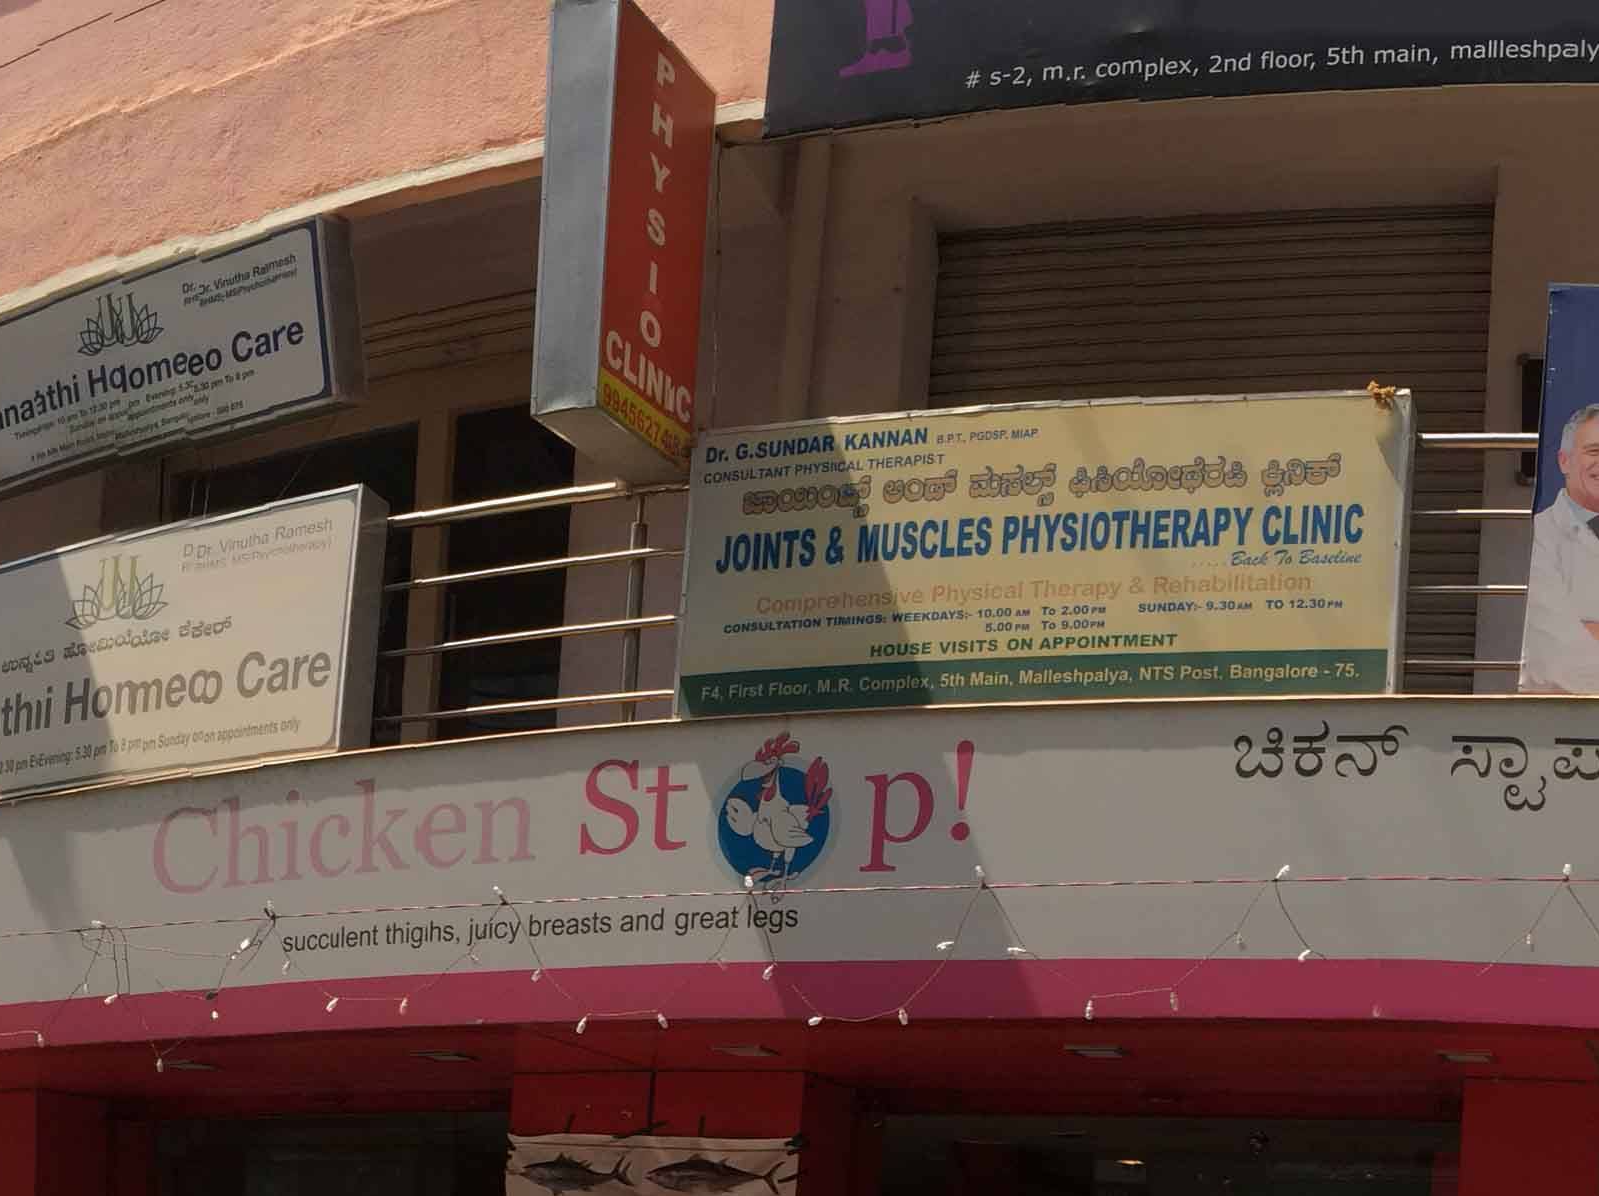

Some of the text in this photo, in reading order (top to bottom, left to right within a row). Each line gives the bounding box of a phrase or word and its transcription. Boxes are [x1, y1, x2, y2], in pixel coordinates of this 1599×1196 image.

[990, 67, 1033, 87] s-2,
[1095, 56, 1199, 81] complex,
[1208, 53, 1252, 74] 2nd
[1261, 50, 1316, 70] floor,
[1326, 45, 1364, 66] 5th
[1374, 43, 1438, 65] main,
[231, 320, 305, 363] Care
[705, 446, 730, 464] Dr.
[843, 427, 929, 452] KANNAN
[703, 453, 945, 485] CONSULTANT THERAPIST
[716, 502, 1365, 574] JOINTS & MUSCLES PHYSIOTHERAPY CLINIC
[1274, 549, 1294, 566] To
[1298, 548, 1364, 566] Baseline
[756, 571, 1313, 616] Comprehensive Physical Therapy & Rehabilitation
[1266, 599, 1284, 611] TO
[869, 633, 1178, 659] HOUSE VISITS ON APPOINTMENT
[236, 649, 333, 699] Care
[728, 681, 764, 701] First
[767, 680, 812, 698] Floor,
[858, 674, 935, 693] Complex,
[939, 671, 966, 688] 5th
[968, 671, 1014, 688] Main,
[1018, 666, 1134, 687] Malleshpalya,
[1138, 665, 1176, 682] NTS
[1230, 662, 1318, 685] Bangalore
[1233, 722, 1410, 781] ಚಿಕನ್
[152, 785, 537, 897] Chicken
[282, 904, 799, 954] succulent juicy breasts and great legs
